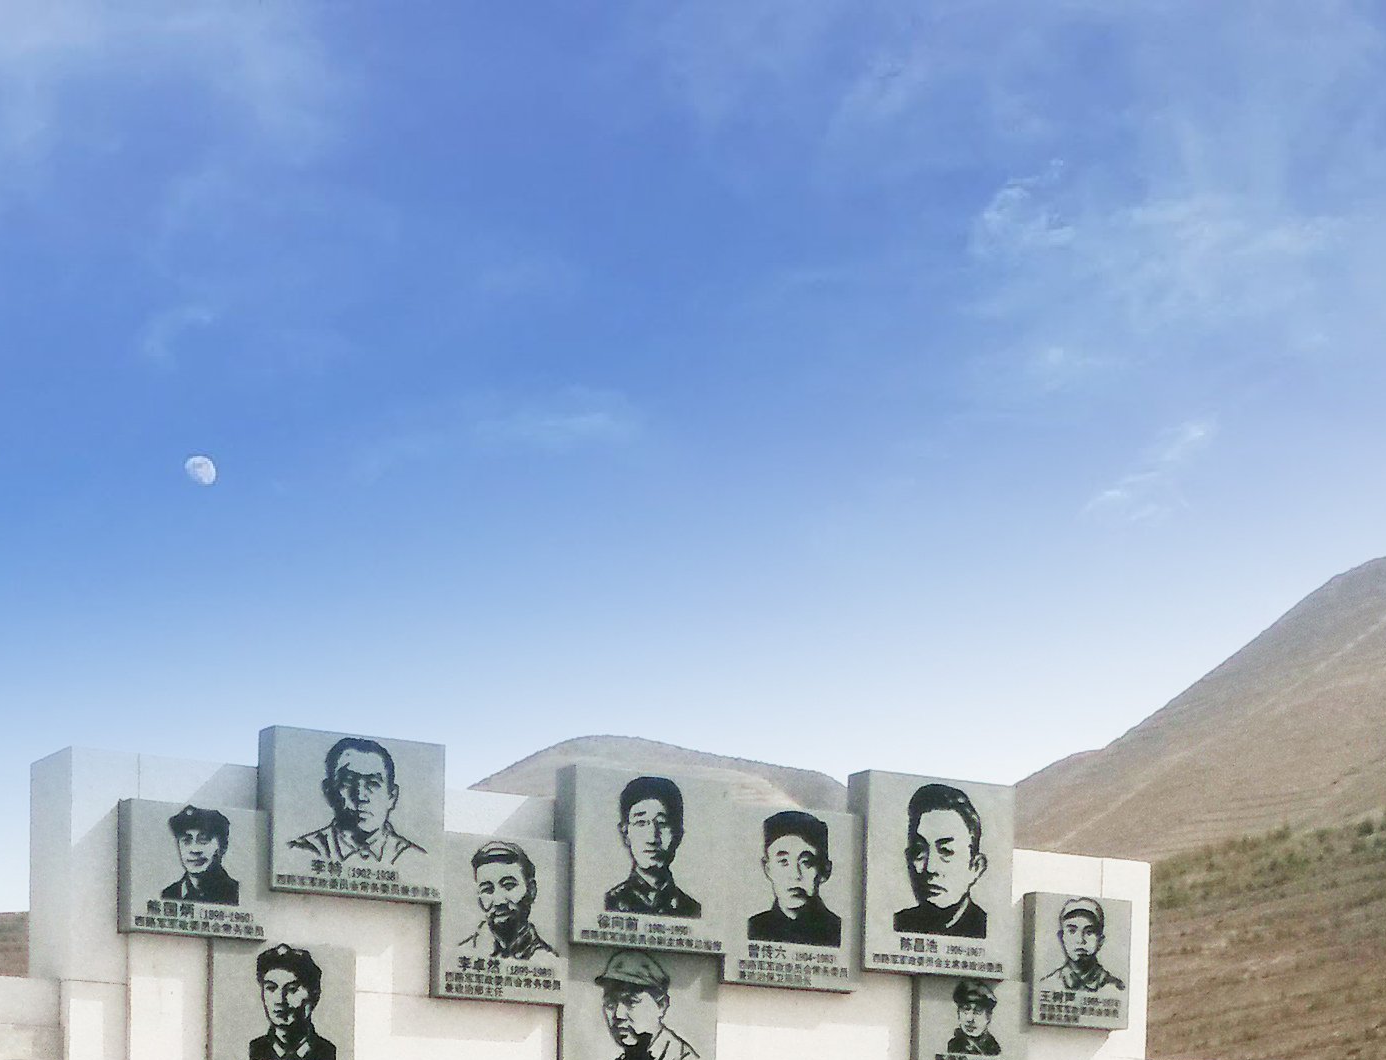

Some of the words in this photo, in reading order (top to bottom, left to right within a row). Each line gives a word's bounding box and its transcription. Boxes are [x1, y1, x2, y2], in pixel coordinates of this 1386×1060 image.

[311, 859, 342, 877] 李特
[147, 900, 194, 919] 熊国炳
[597, 913, 639, 931] 徐向前
[748, 943, 786, 960] 曾传六
[900, 936, 938, 953] 陈昌浩
[458, 955, 500, 974] 李卓然
